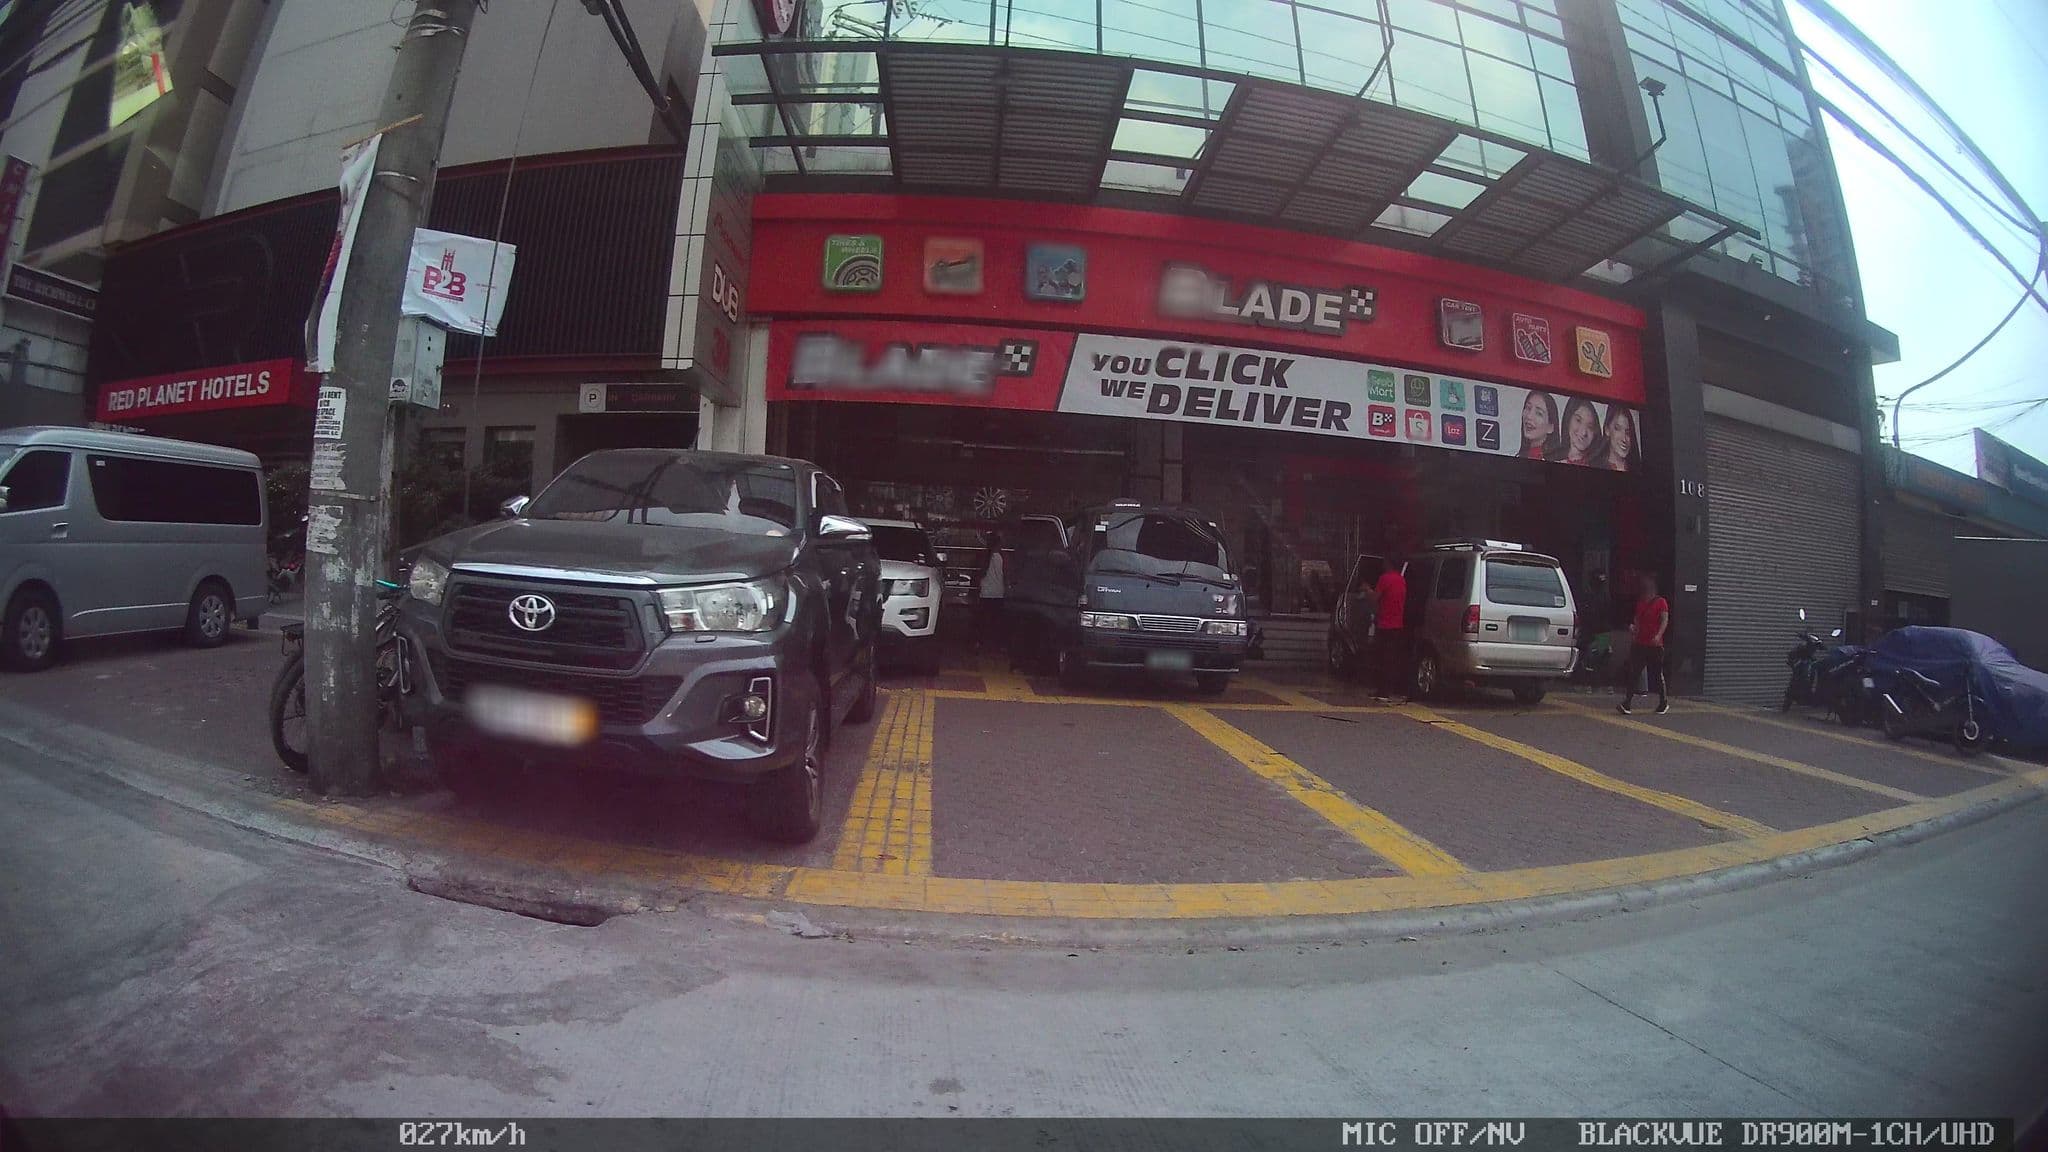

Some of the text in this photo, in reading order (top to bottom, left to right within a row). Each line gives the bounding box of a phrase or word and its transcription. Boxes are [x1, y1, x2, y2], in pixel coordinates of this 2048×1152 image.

[422, 265, 467, 296] B2B
[712, 263, 739, 323] DUB
[1092, 347, 1295, 389] YOU CLICK
[108, 370, 270, 411] RED PLANET HOTELS
[1100, 378, 1352, 432] WE DELIVER
[1369, 386, 1394, 398] Mart
[1481, 422, 1496, 441] Z
[1681, 479, 1705, 498] 108
